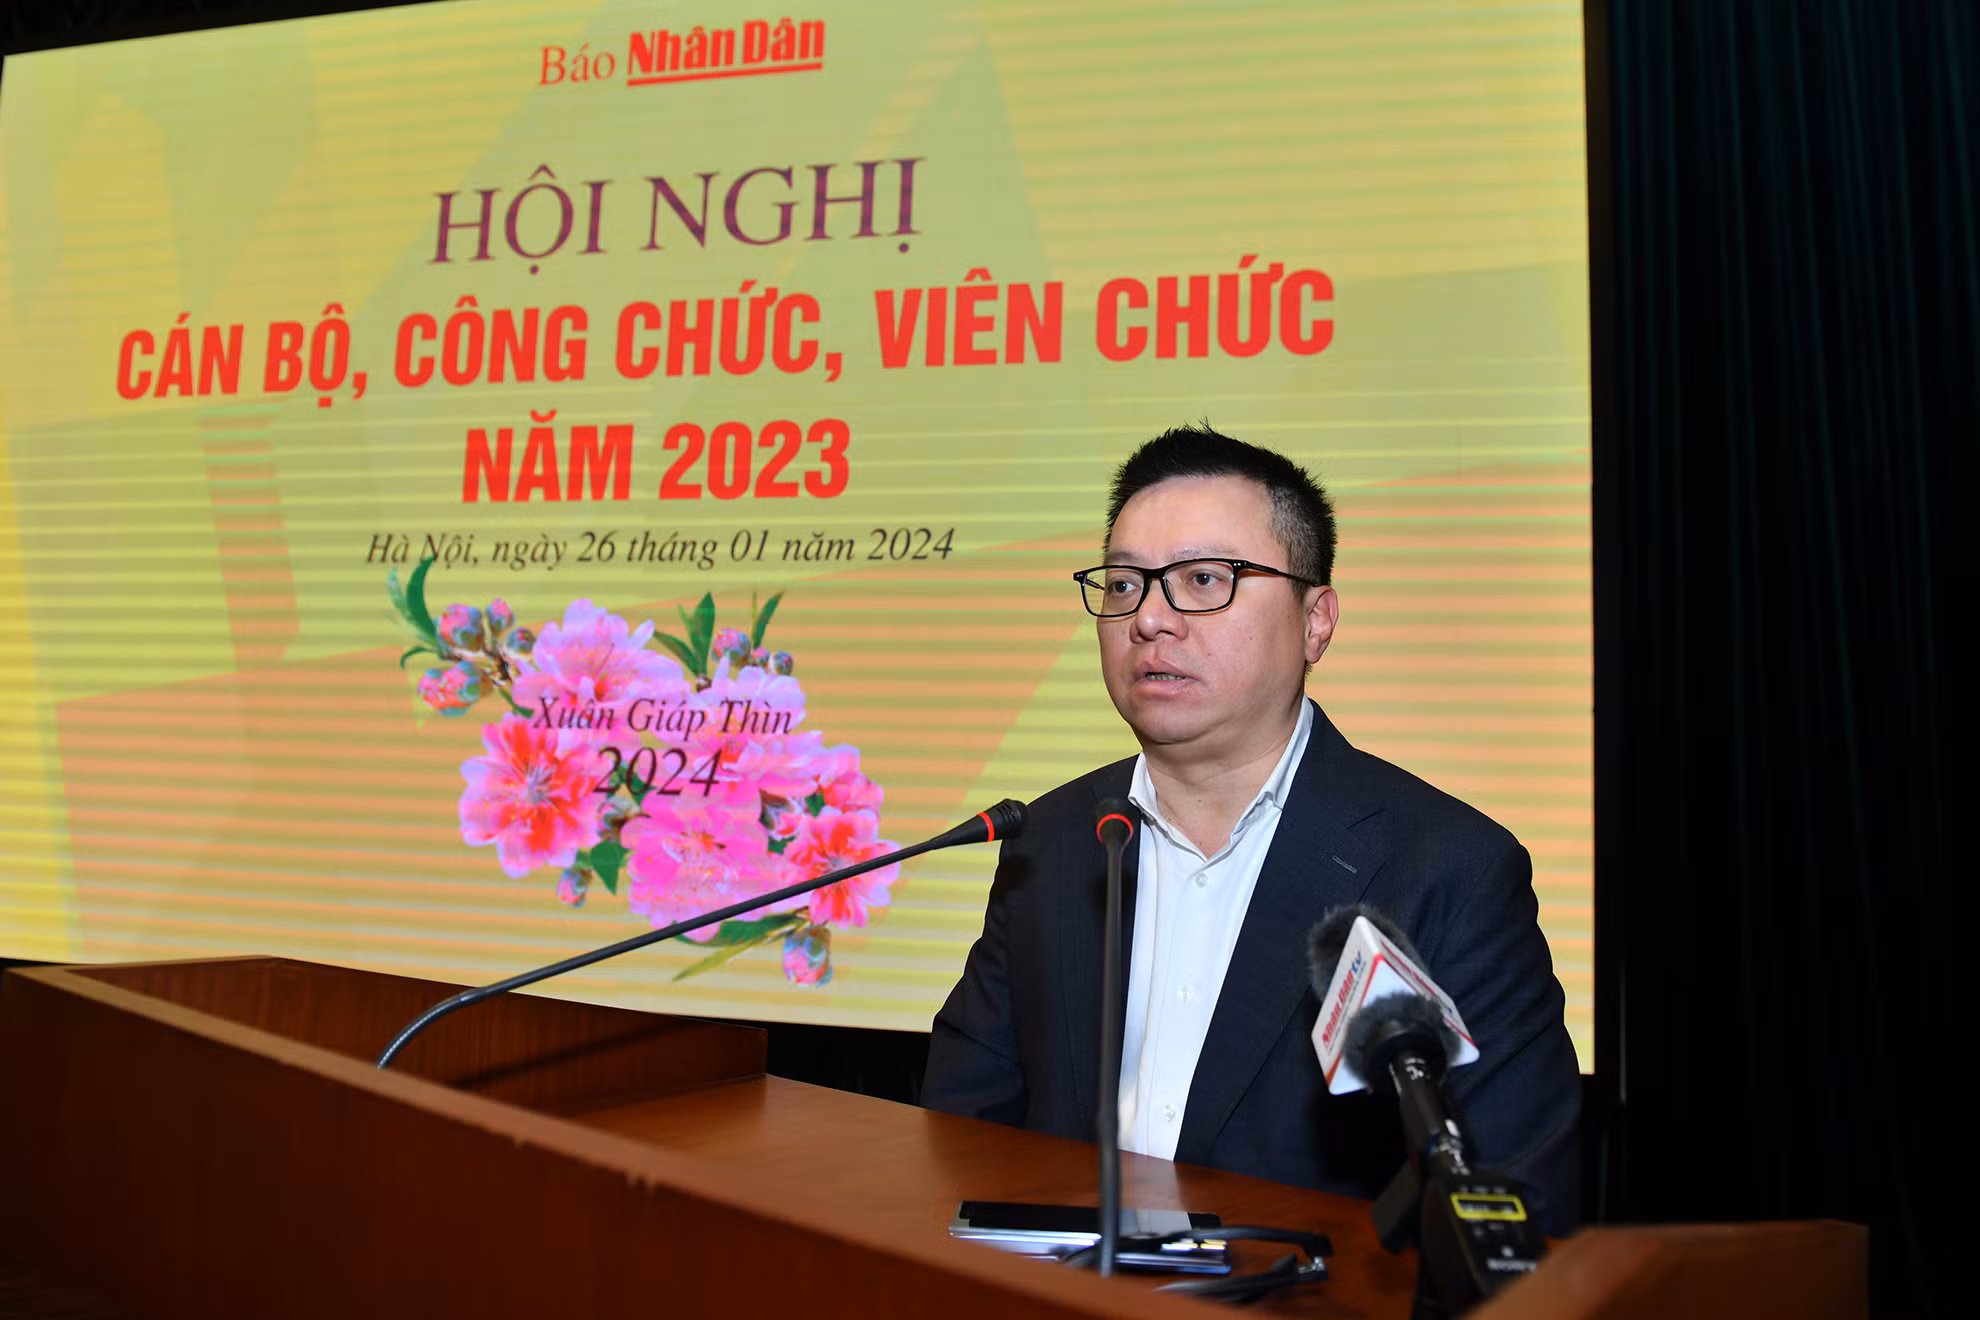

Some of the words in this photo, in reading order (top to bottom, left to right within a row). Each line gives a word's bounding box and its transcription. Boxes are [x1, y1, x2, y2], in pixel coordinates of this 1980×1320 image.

[538, 44, 616, 86] Báo
[628, 25, 735, 75] Nhân
[742, 16, 825, 64] Dân
[428, 164, 614, 275] HỘI
[641, 157, 926, 253] NGHỊ
[116, 312, 245, 400] CÁN
[263, 303, 367, 408] BỘ,
[395, 295, 588, 388] CÔNG
[615, 279, 843, 383] CHỨC,
[874, 267, 1063, 369] VIÊN
[1096, 254, 1334, 362] CHỨC
[462, 409, 634, 503] NĂM
[659, 418, 851, 500] 2023
[367, 532, 409, 563] Hà
[420, 532, 478, 569] Nội,
[491, 532, 567, 571] ngày
[577, 530, 616, 562] 26
[627, 530, 718, 569] tháng
[730, 529, 769, 561] 01
[782, 532, 856, 561] năm
[867, 527, 955, 560] 2024
[533, 696, 615, 729] Xuân
[627, 698, 705, 741] Giáp
[719, 699, 792, 735] Thìn
[593, 746, 722, 797] 2024
